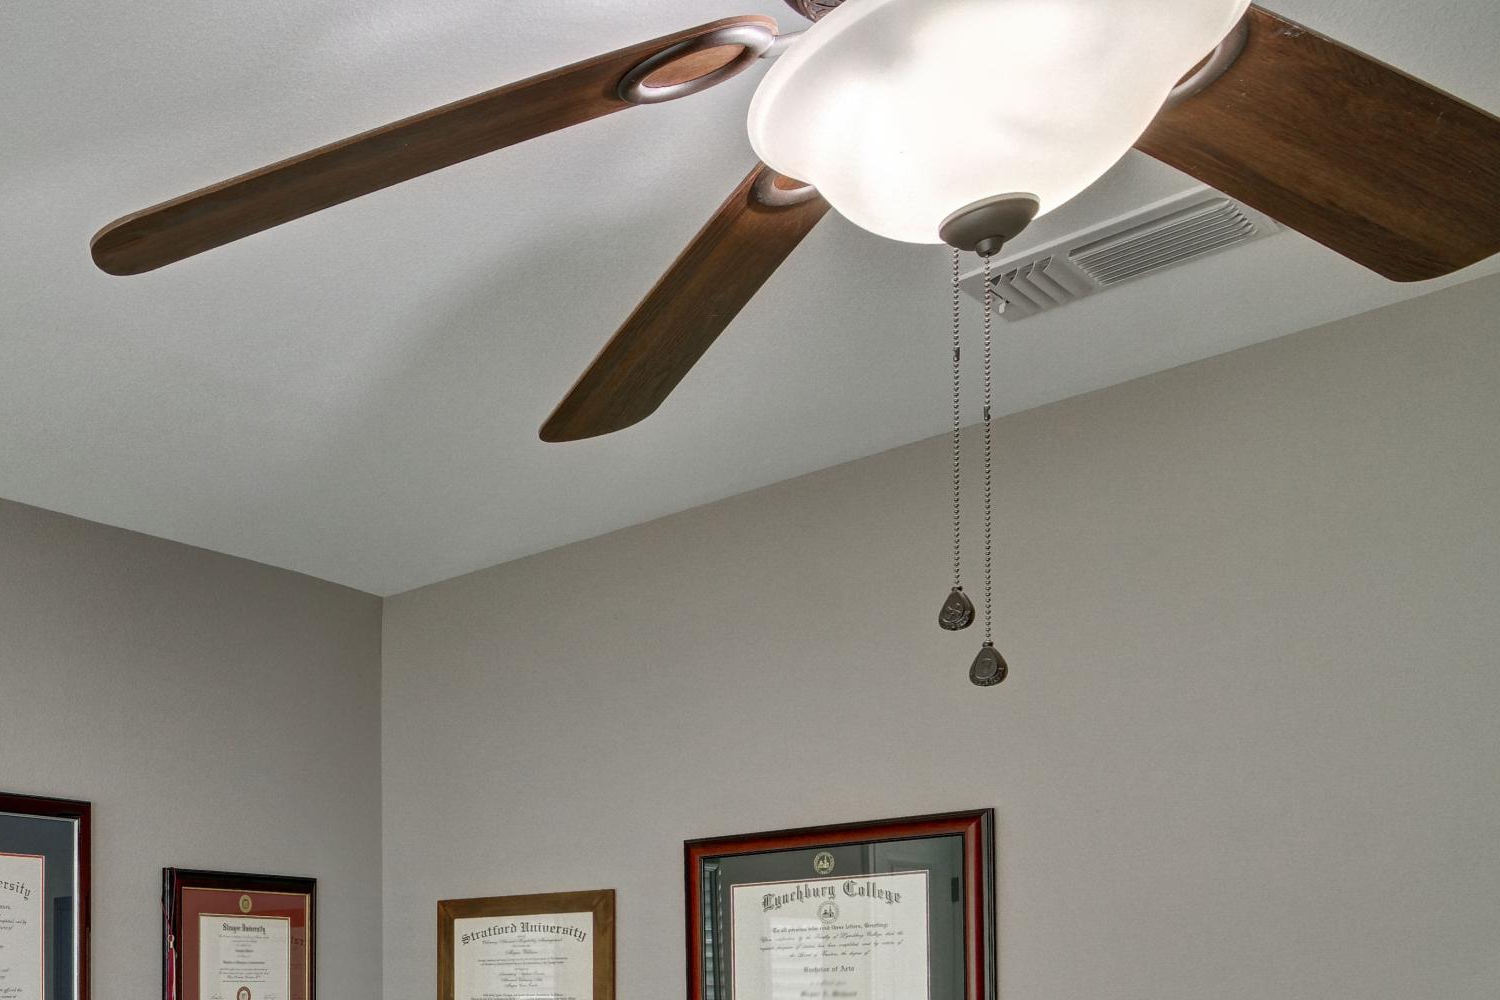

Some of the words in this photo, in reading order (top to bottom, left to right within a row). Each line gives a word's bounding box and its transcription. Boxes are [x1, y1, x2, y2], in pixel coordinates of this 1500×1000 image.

[762, 883, 836, 912] Lynchburg
[842, 880, 901, 904] College
[242, 923, 266, 935] University
[461, 923, 517, 946] Stratford
[520, 922, 587, 943] University
